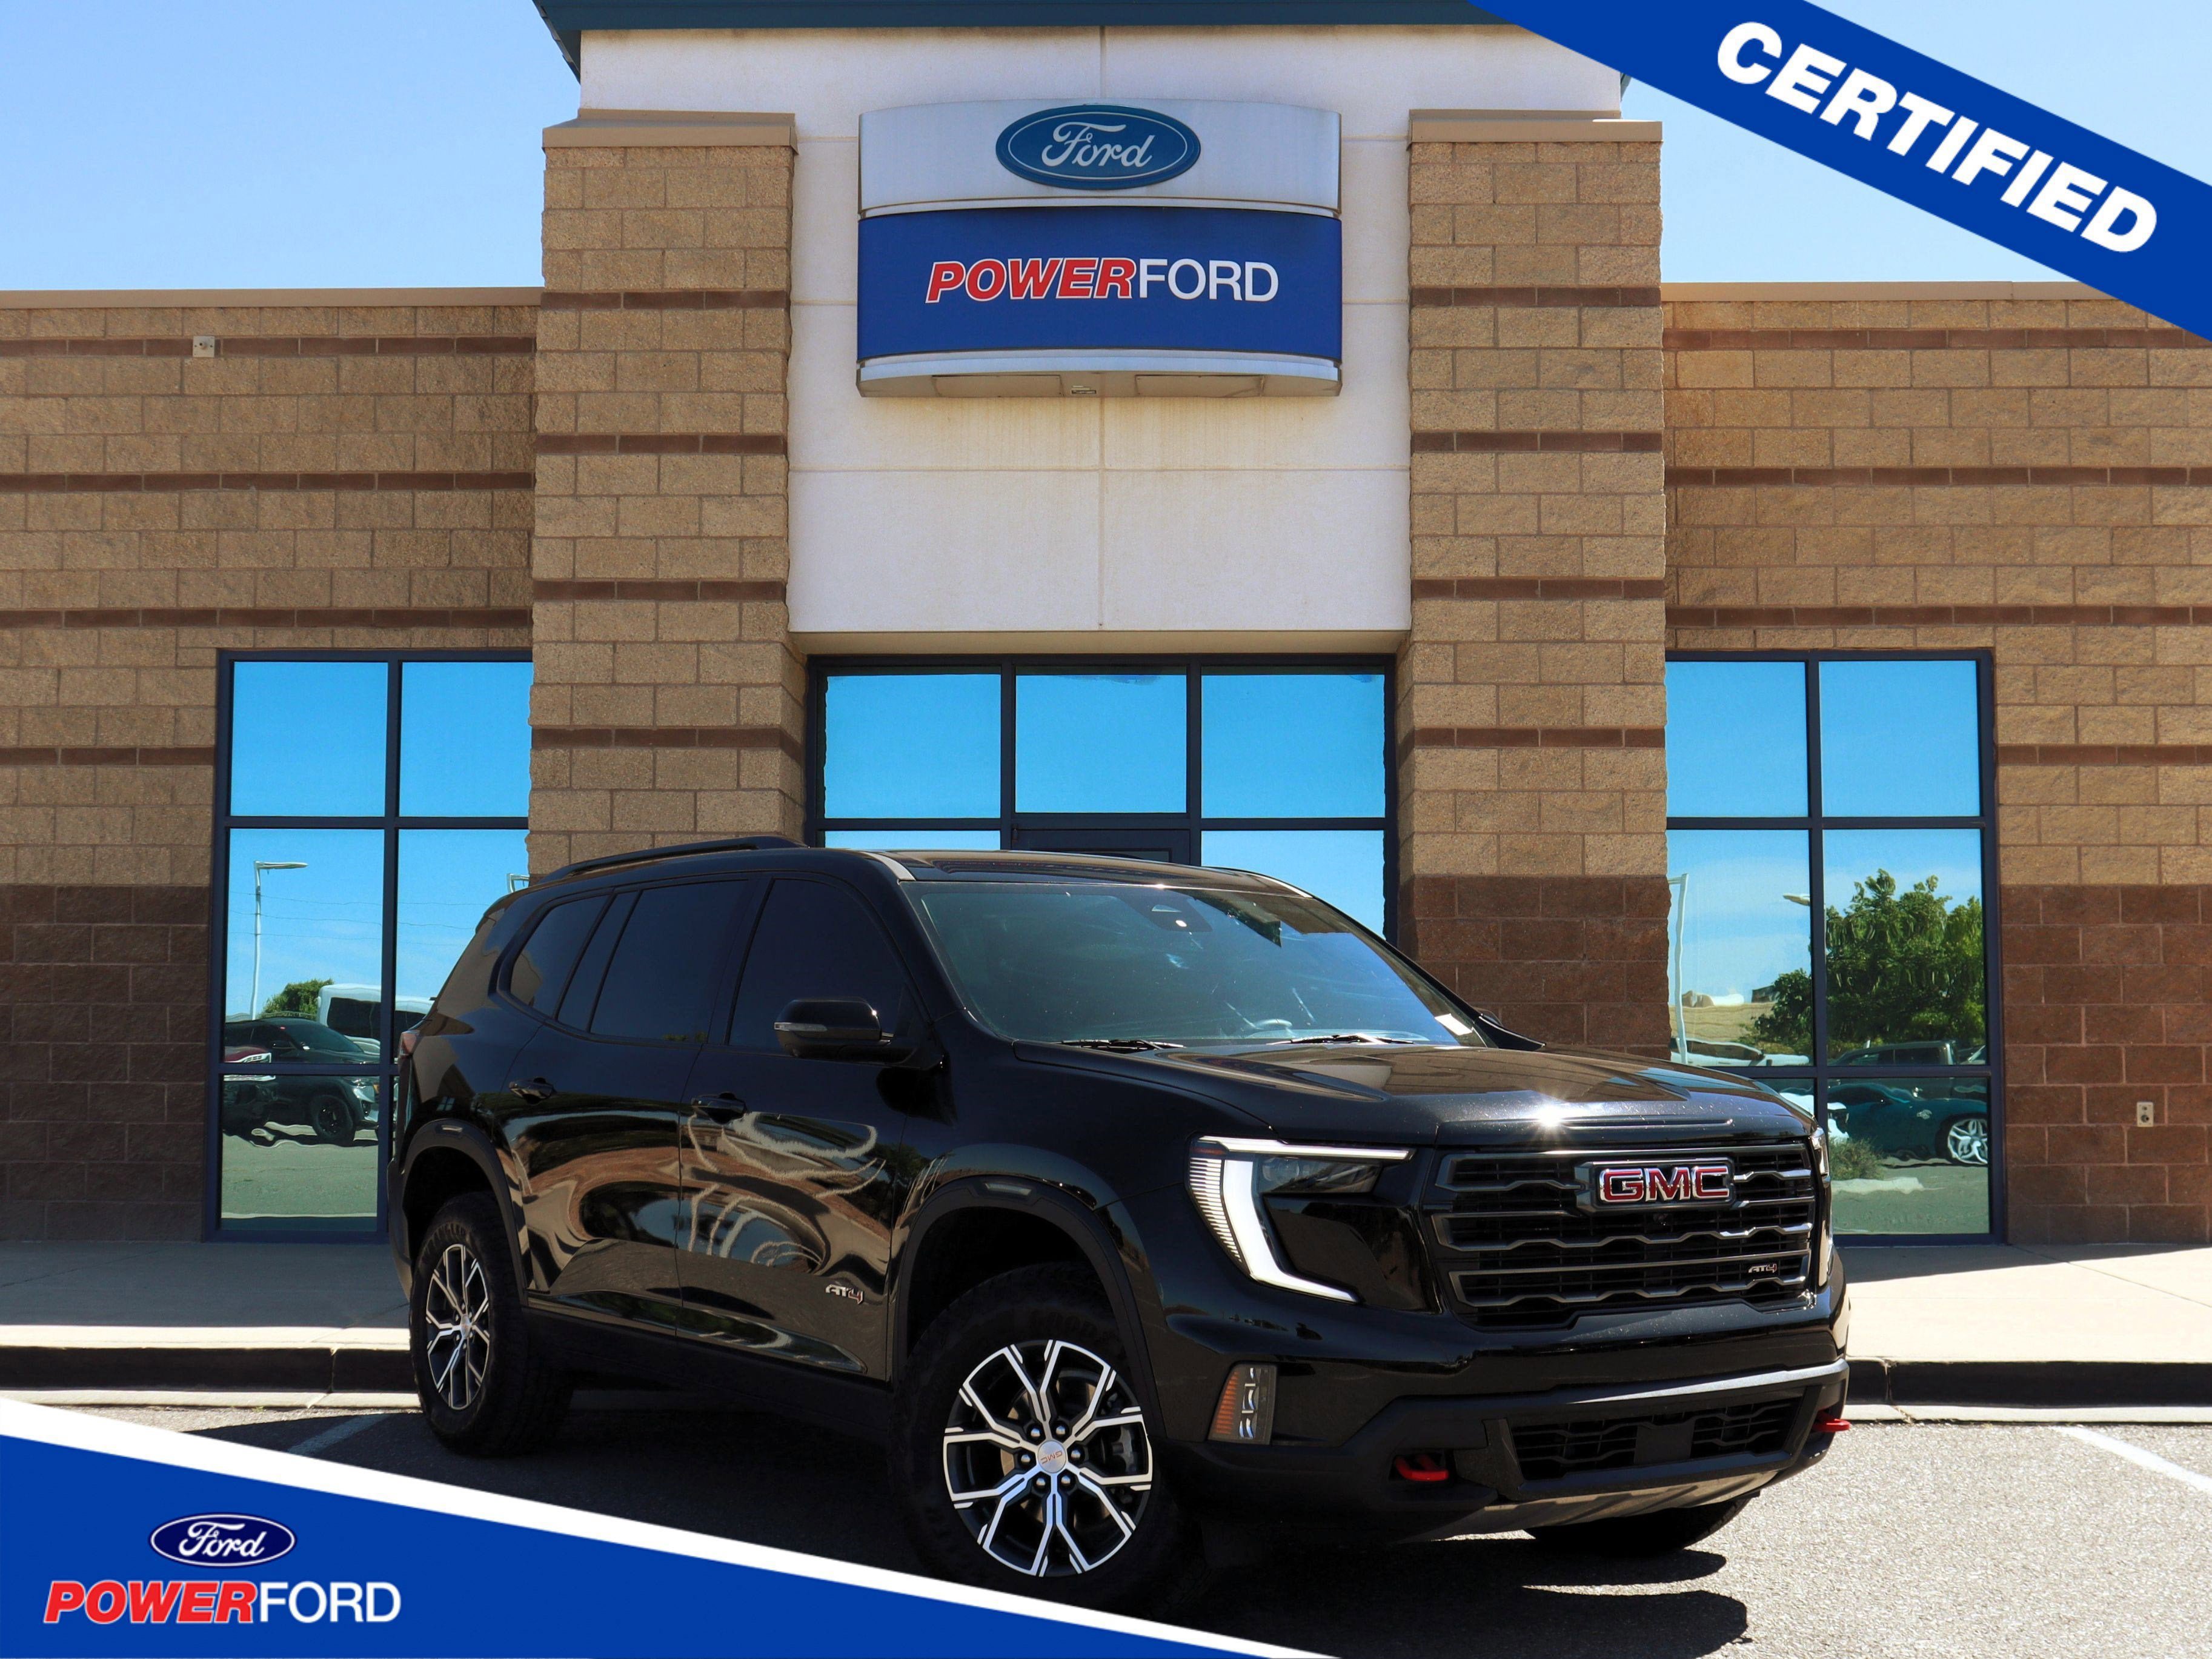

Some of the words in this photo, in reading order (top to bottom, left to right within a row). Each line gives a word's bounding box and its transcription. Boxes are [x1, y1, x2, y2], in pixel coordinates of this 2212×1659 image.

[1041, 122, 1155, 168] Ford
[1599, 1165, 1730, 1202] GMC
[1748, 1263, 1778, 1273] AT4
[825, 1284, 863, 1305] AT4
[1040, 1450, 1063, 1465] GMC
